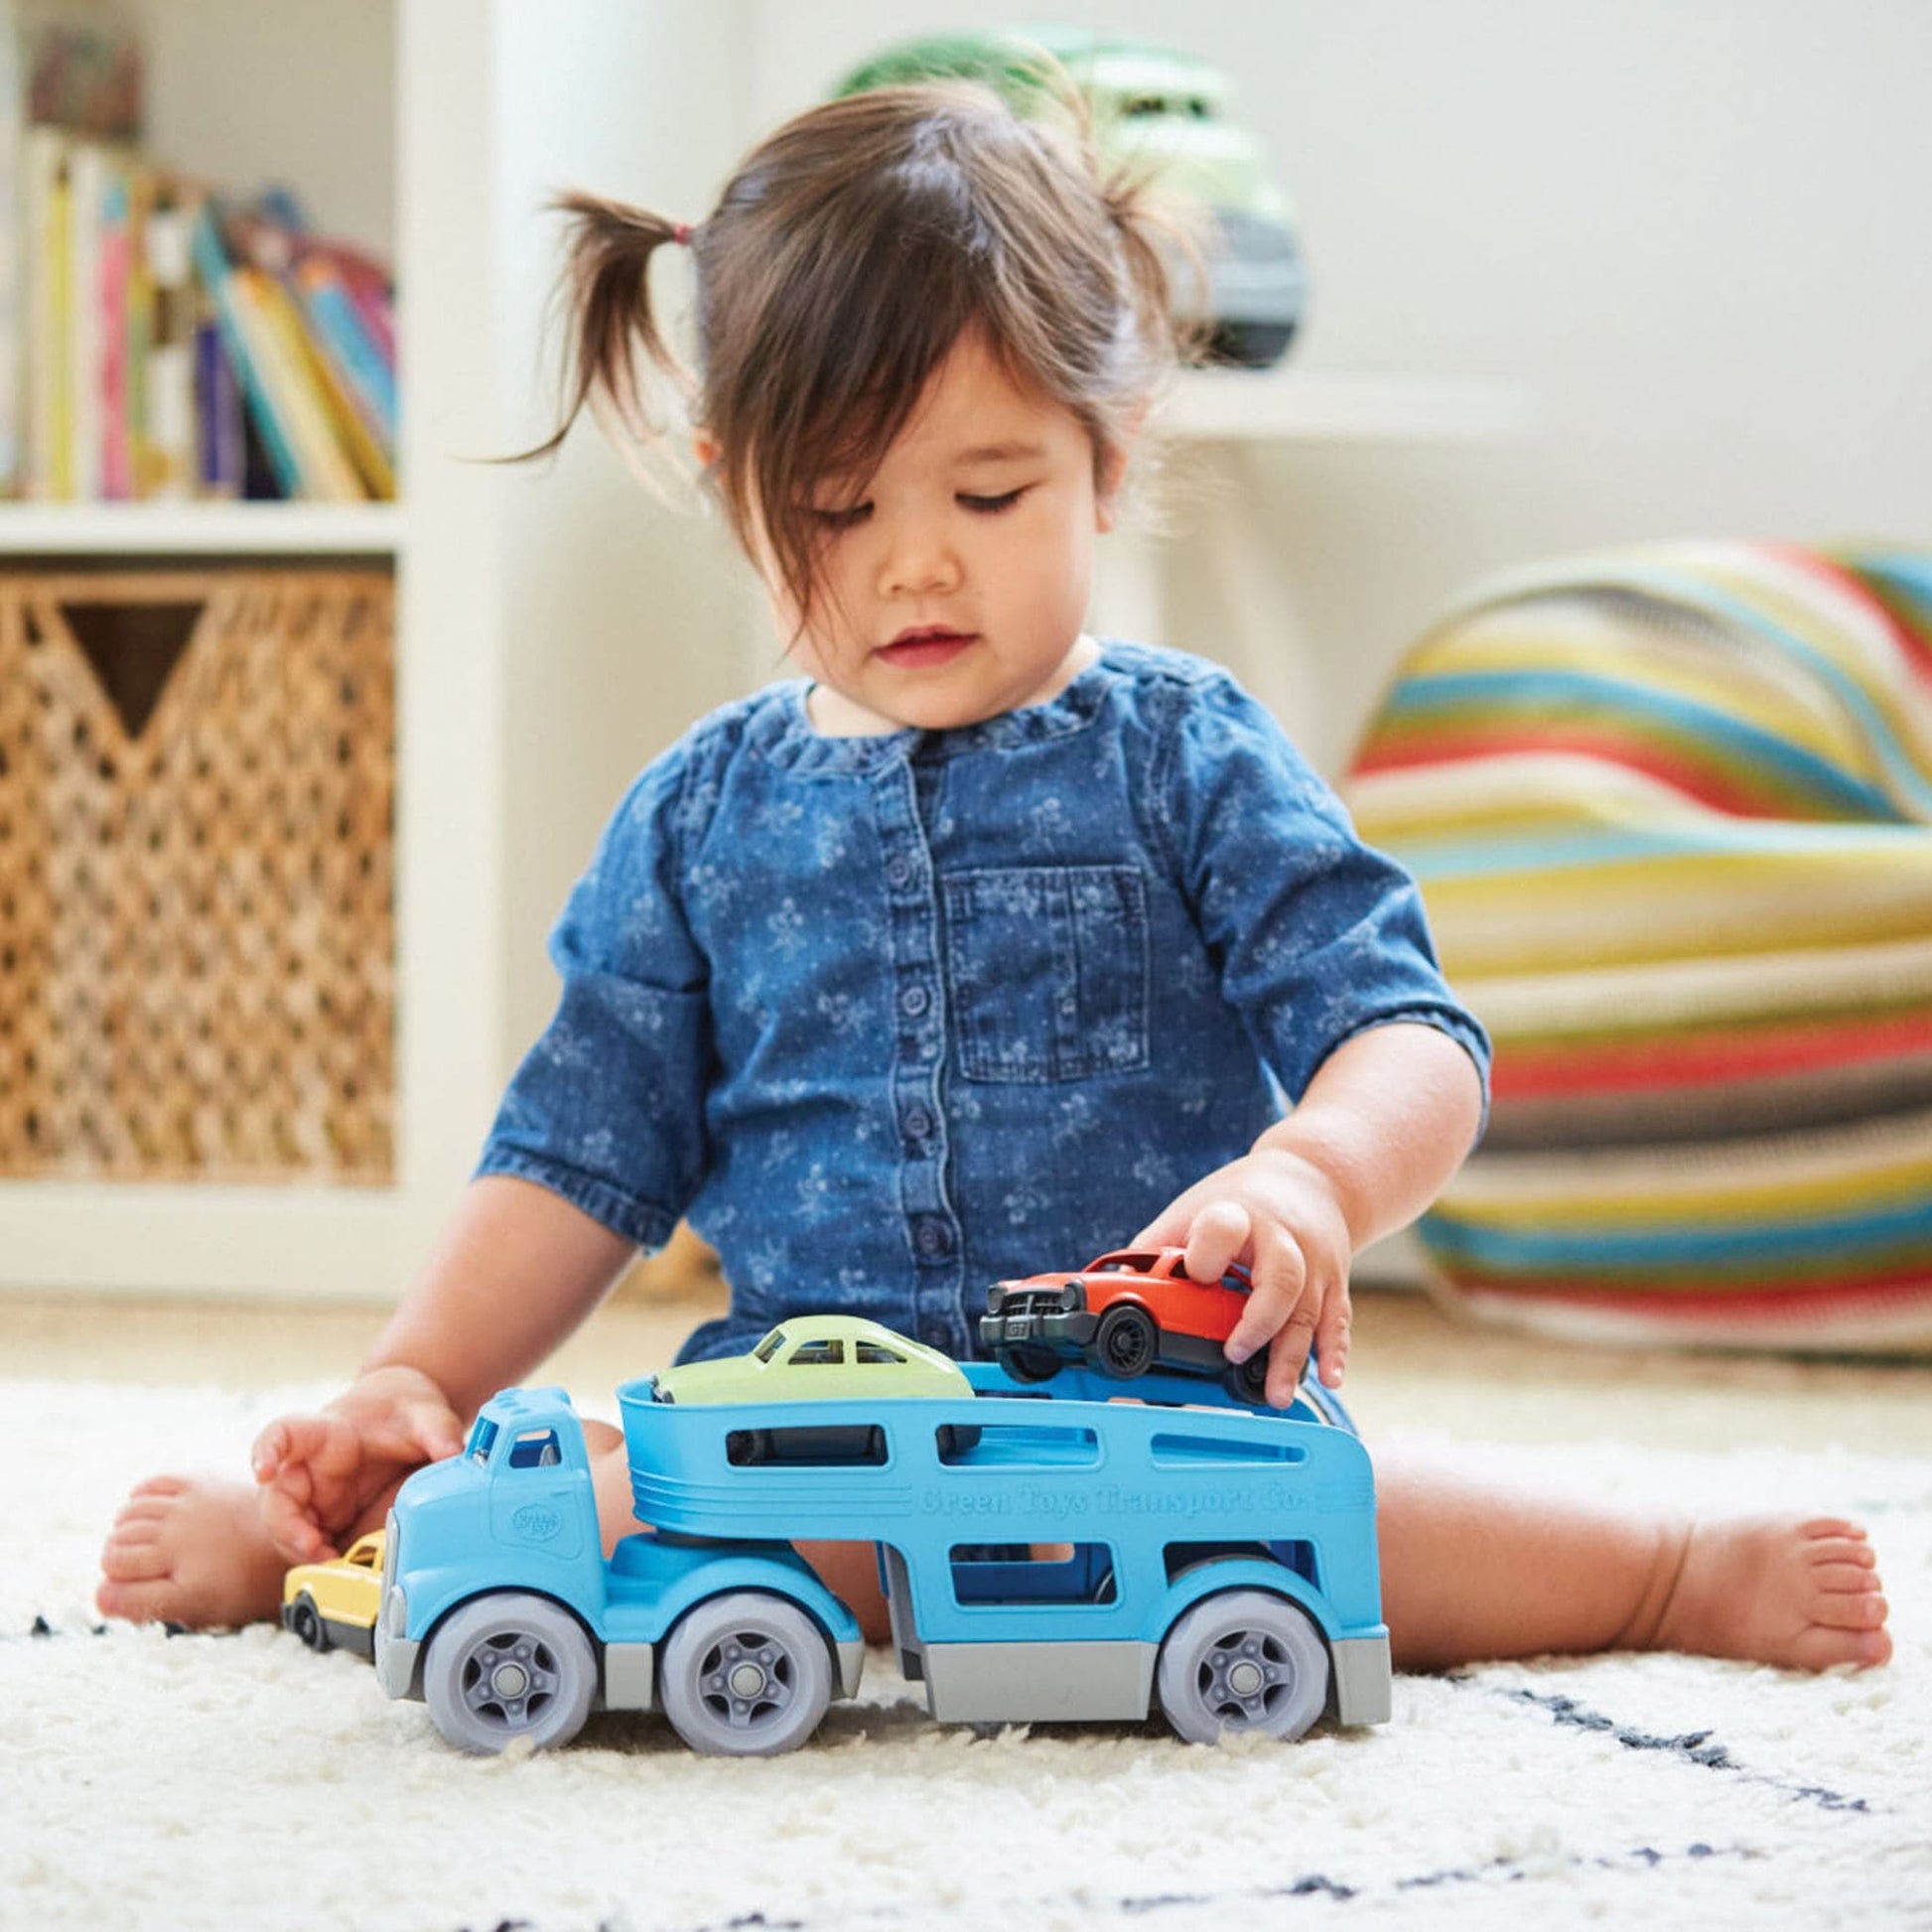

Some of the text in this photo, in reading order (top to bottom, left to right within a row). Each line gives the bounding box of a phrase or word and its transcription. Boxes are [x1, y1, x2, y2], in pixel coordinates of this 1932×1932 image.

[921, 1487, 1011, 1515] Green
[1016, 1483, 1087, 1521] Toys
[1096, 1483, 1254, 1520] Transport
